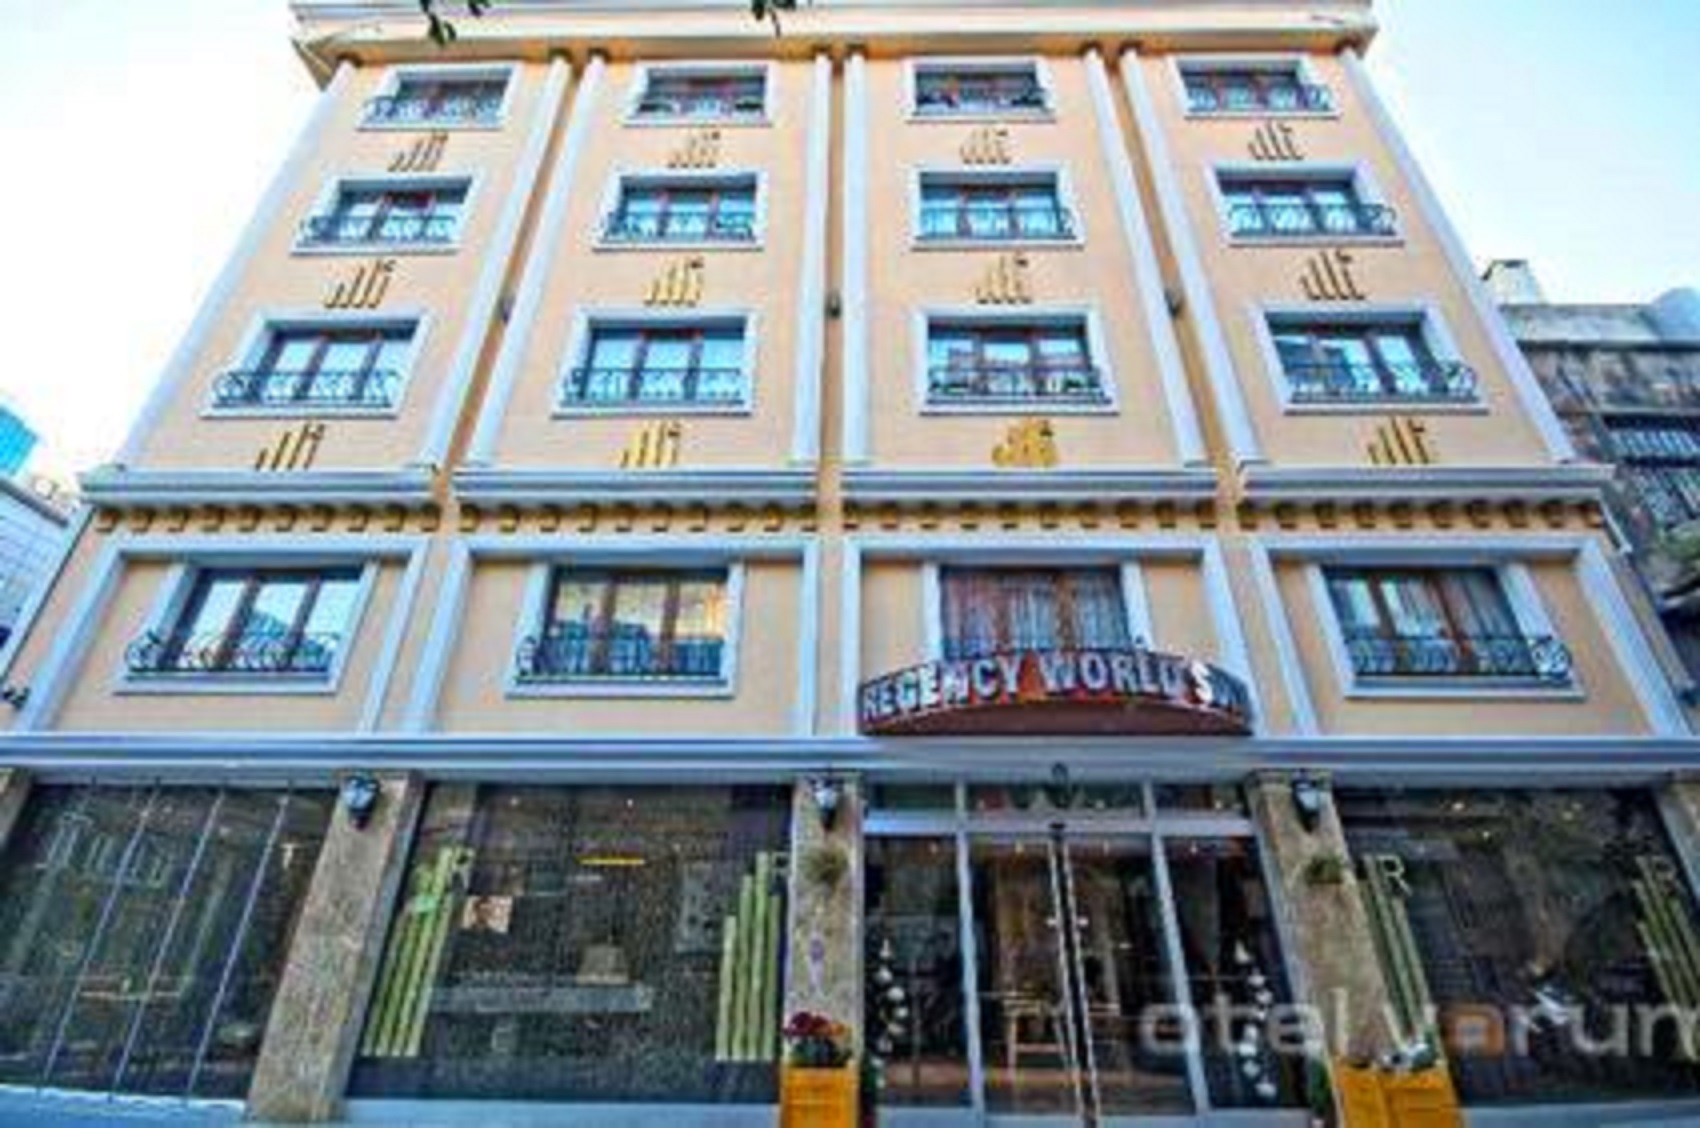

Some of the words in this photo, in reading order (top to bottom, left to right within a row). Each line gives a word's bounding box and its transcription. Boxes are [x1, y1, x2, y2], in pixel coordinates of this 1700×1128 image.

[863, 655, 1021, 721] REGENCY
[1037, 650, 1183, 700] WORLD
[1376, 853, 1413, 897] R
